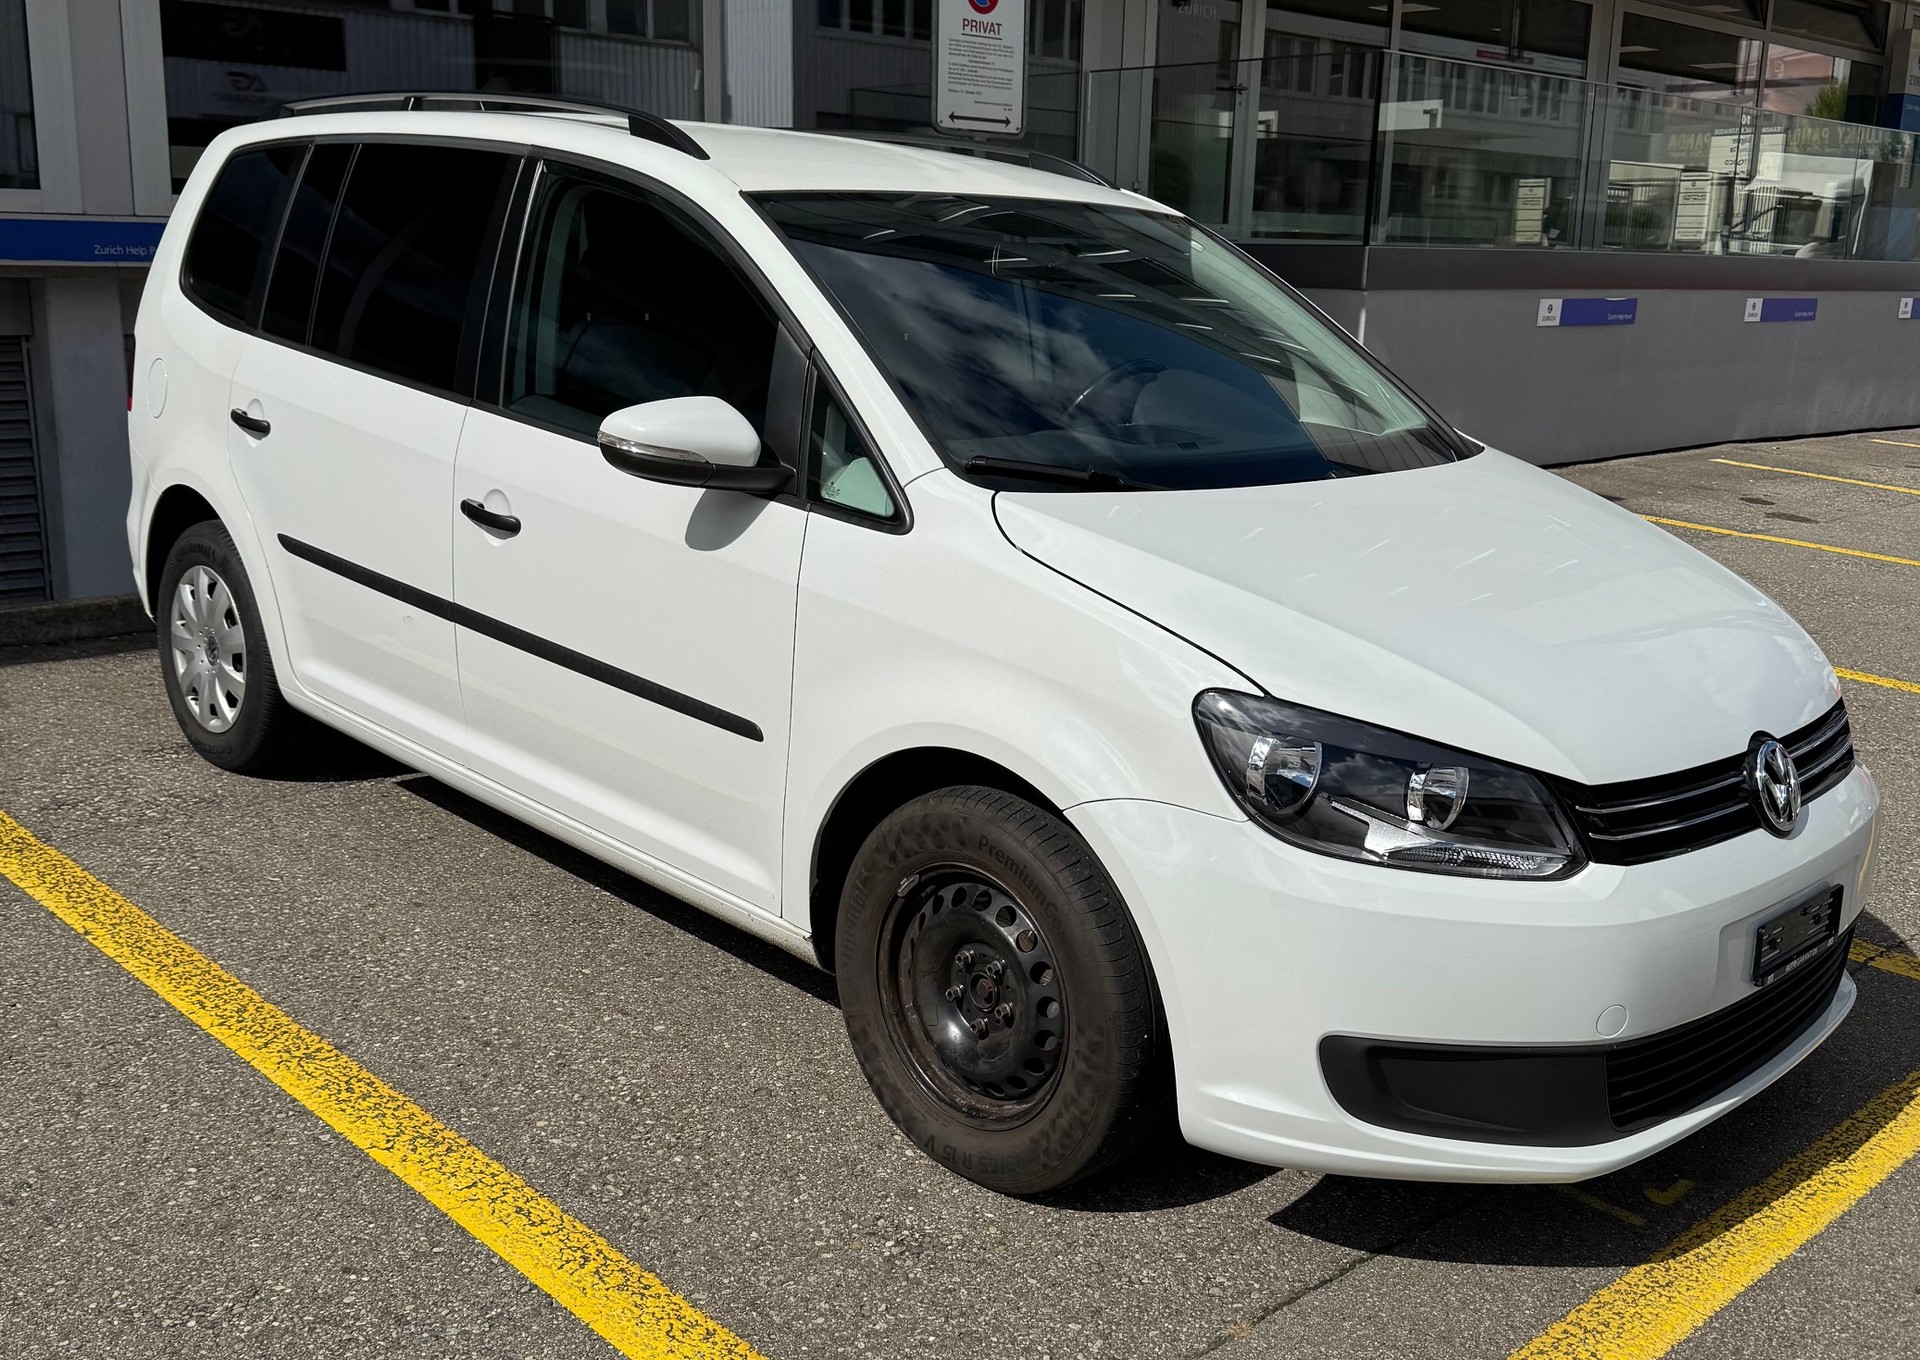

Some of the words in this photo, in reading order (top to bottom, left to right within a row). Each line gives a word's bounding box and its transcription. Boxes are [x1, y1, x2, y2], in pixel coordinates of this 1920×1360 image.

[962, 18, 1003, 36] PRIVAT
[94, 244, 124, 255] Zurich
[126, 245, 147, 257] Help
